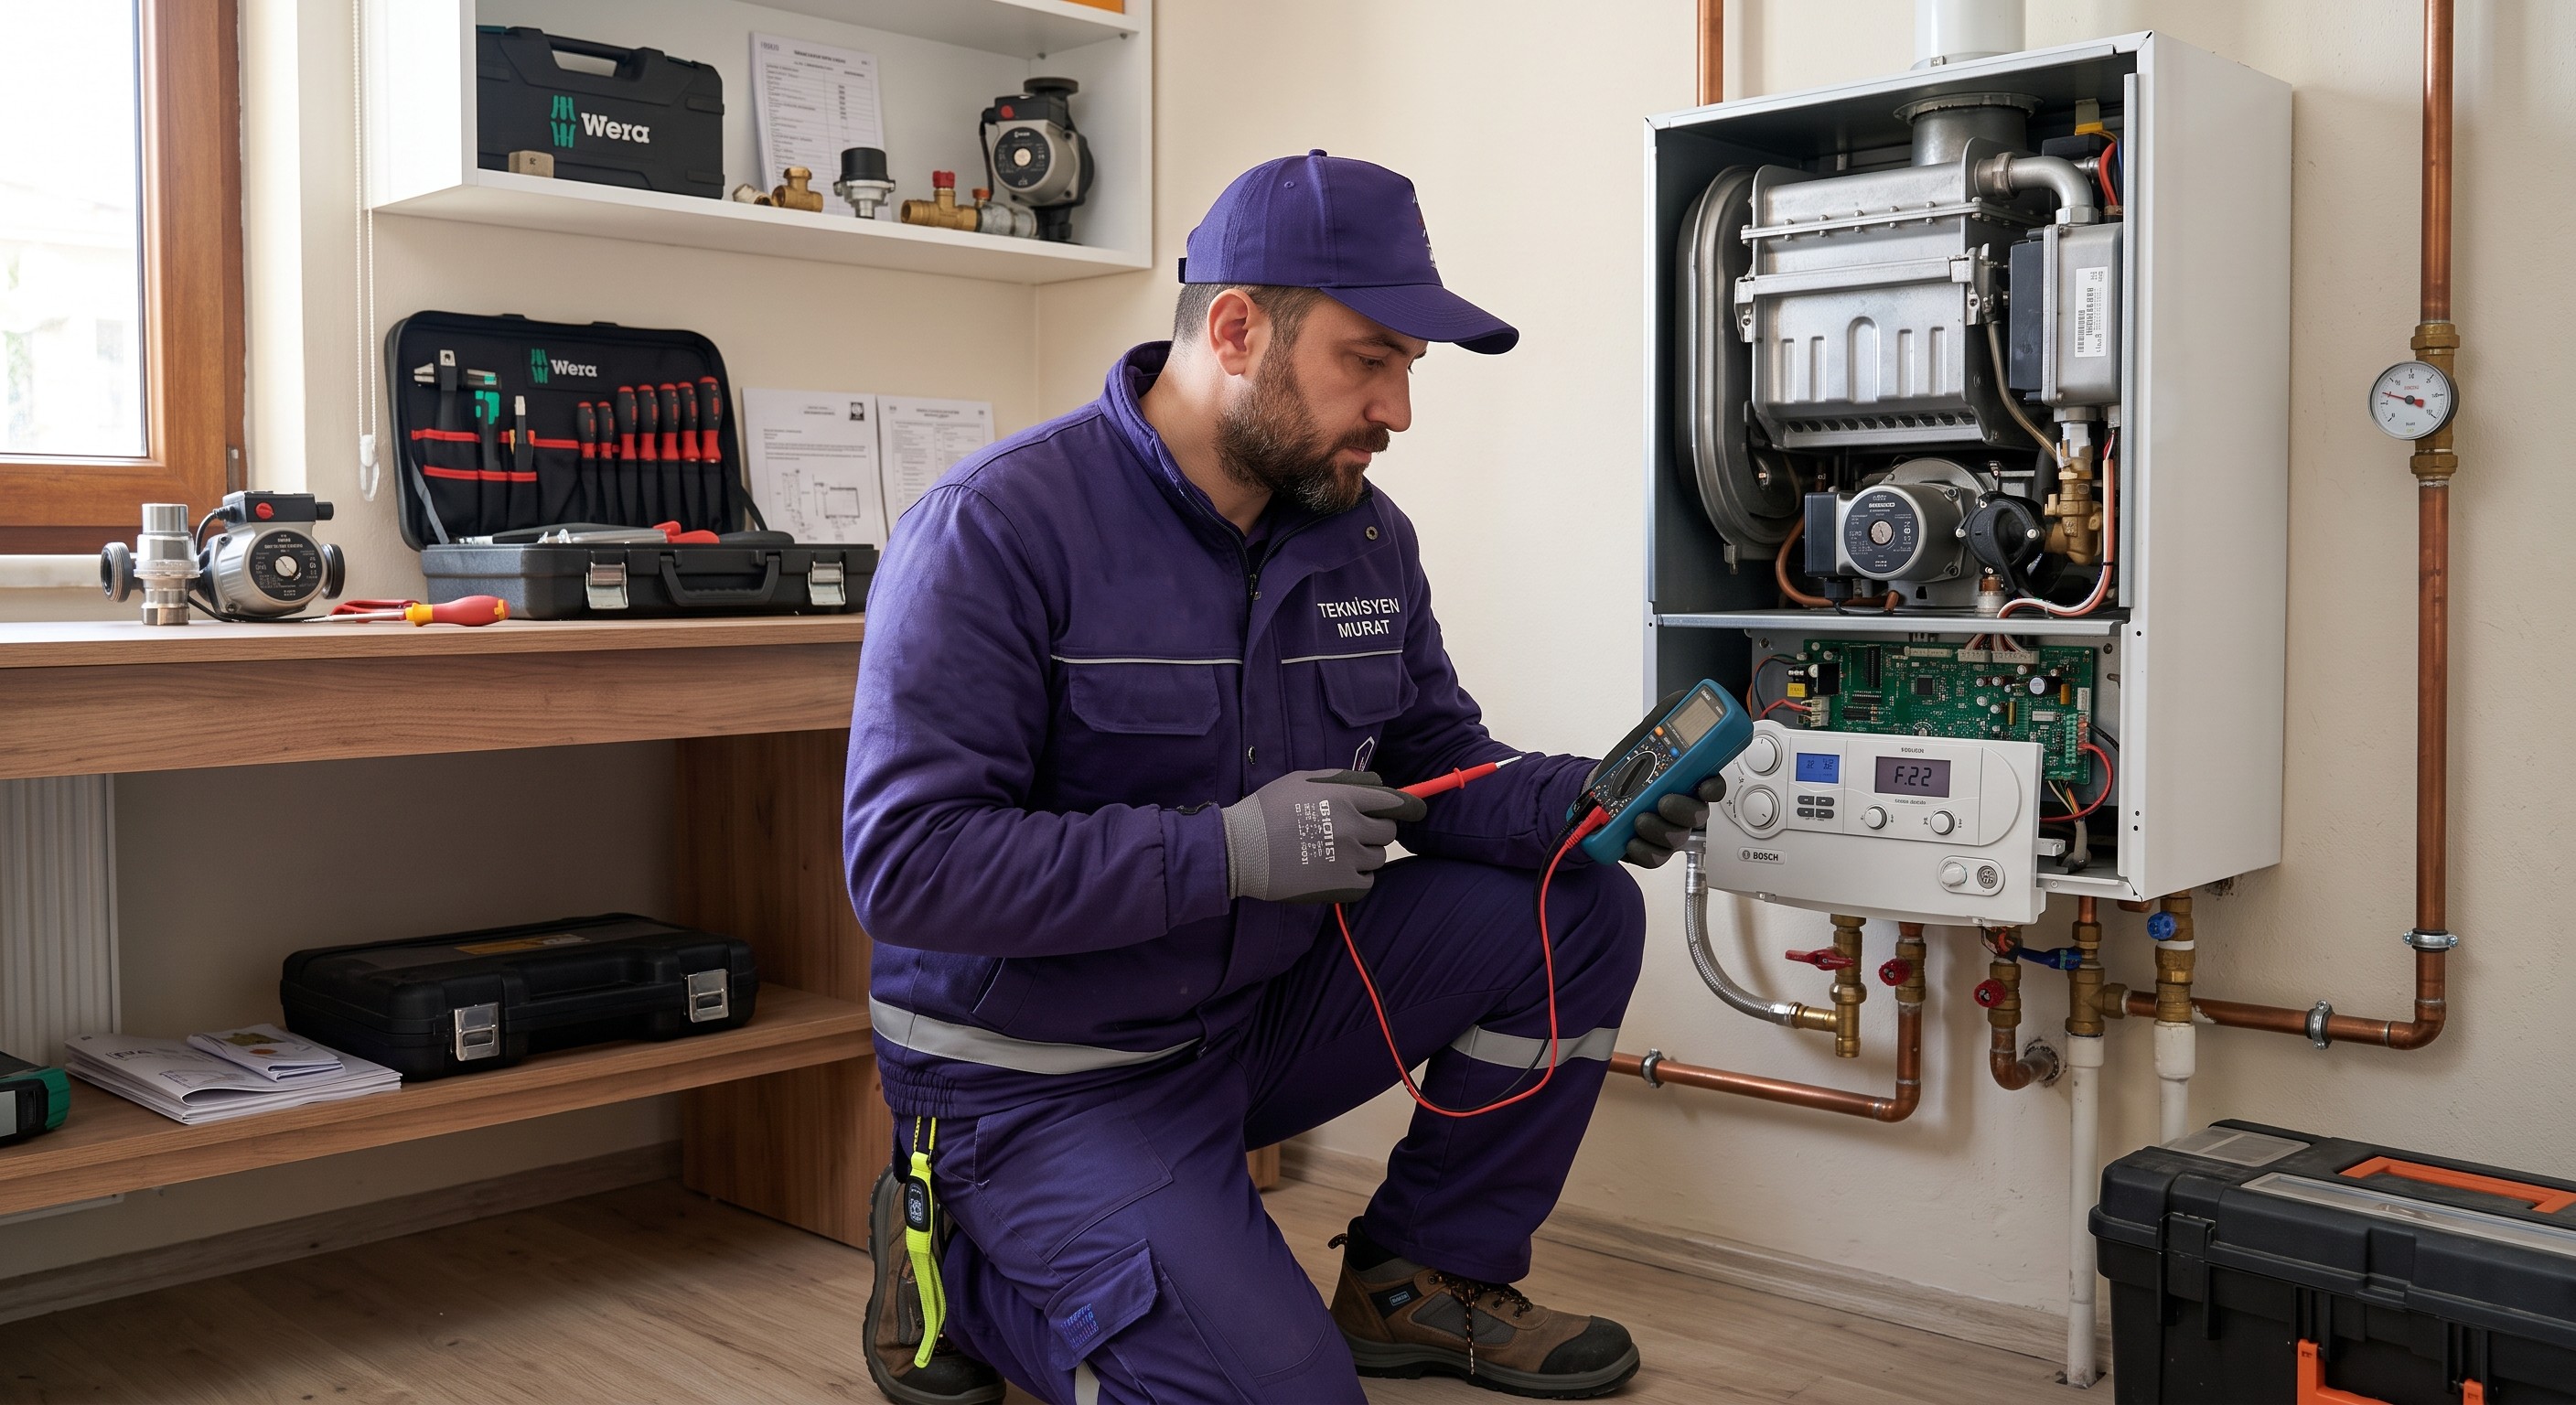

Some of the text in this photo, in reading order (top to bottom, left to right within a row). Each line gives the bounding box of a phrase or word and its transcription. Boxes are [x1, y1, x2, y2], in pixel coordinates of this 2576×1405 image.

[581, 112, 650, 144] Wera
[550, 359, 597, 378] Wera
[1317, 596, 1401, 618] TEKNİSYEN
[1337, 619, 1390, 638] MURAT
[1894, 766, 1932, 788] F.22
[1753, 852, 1779, 861] BOSCH
